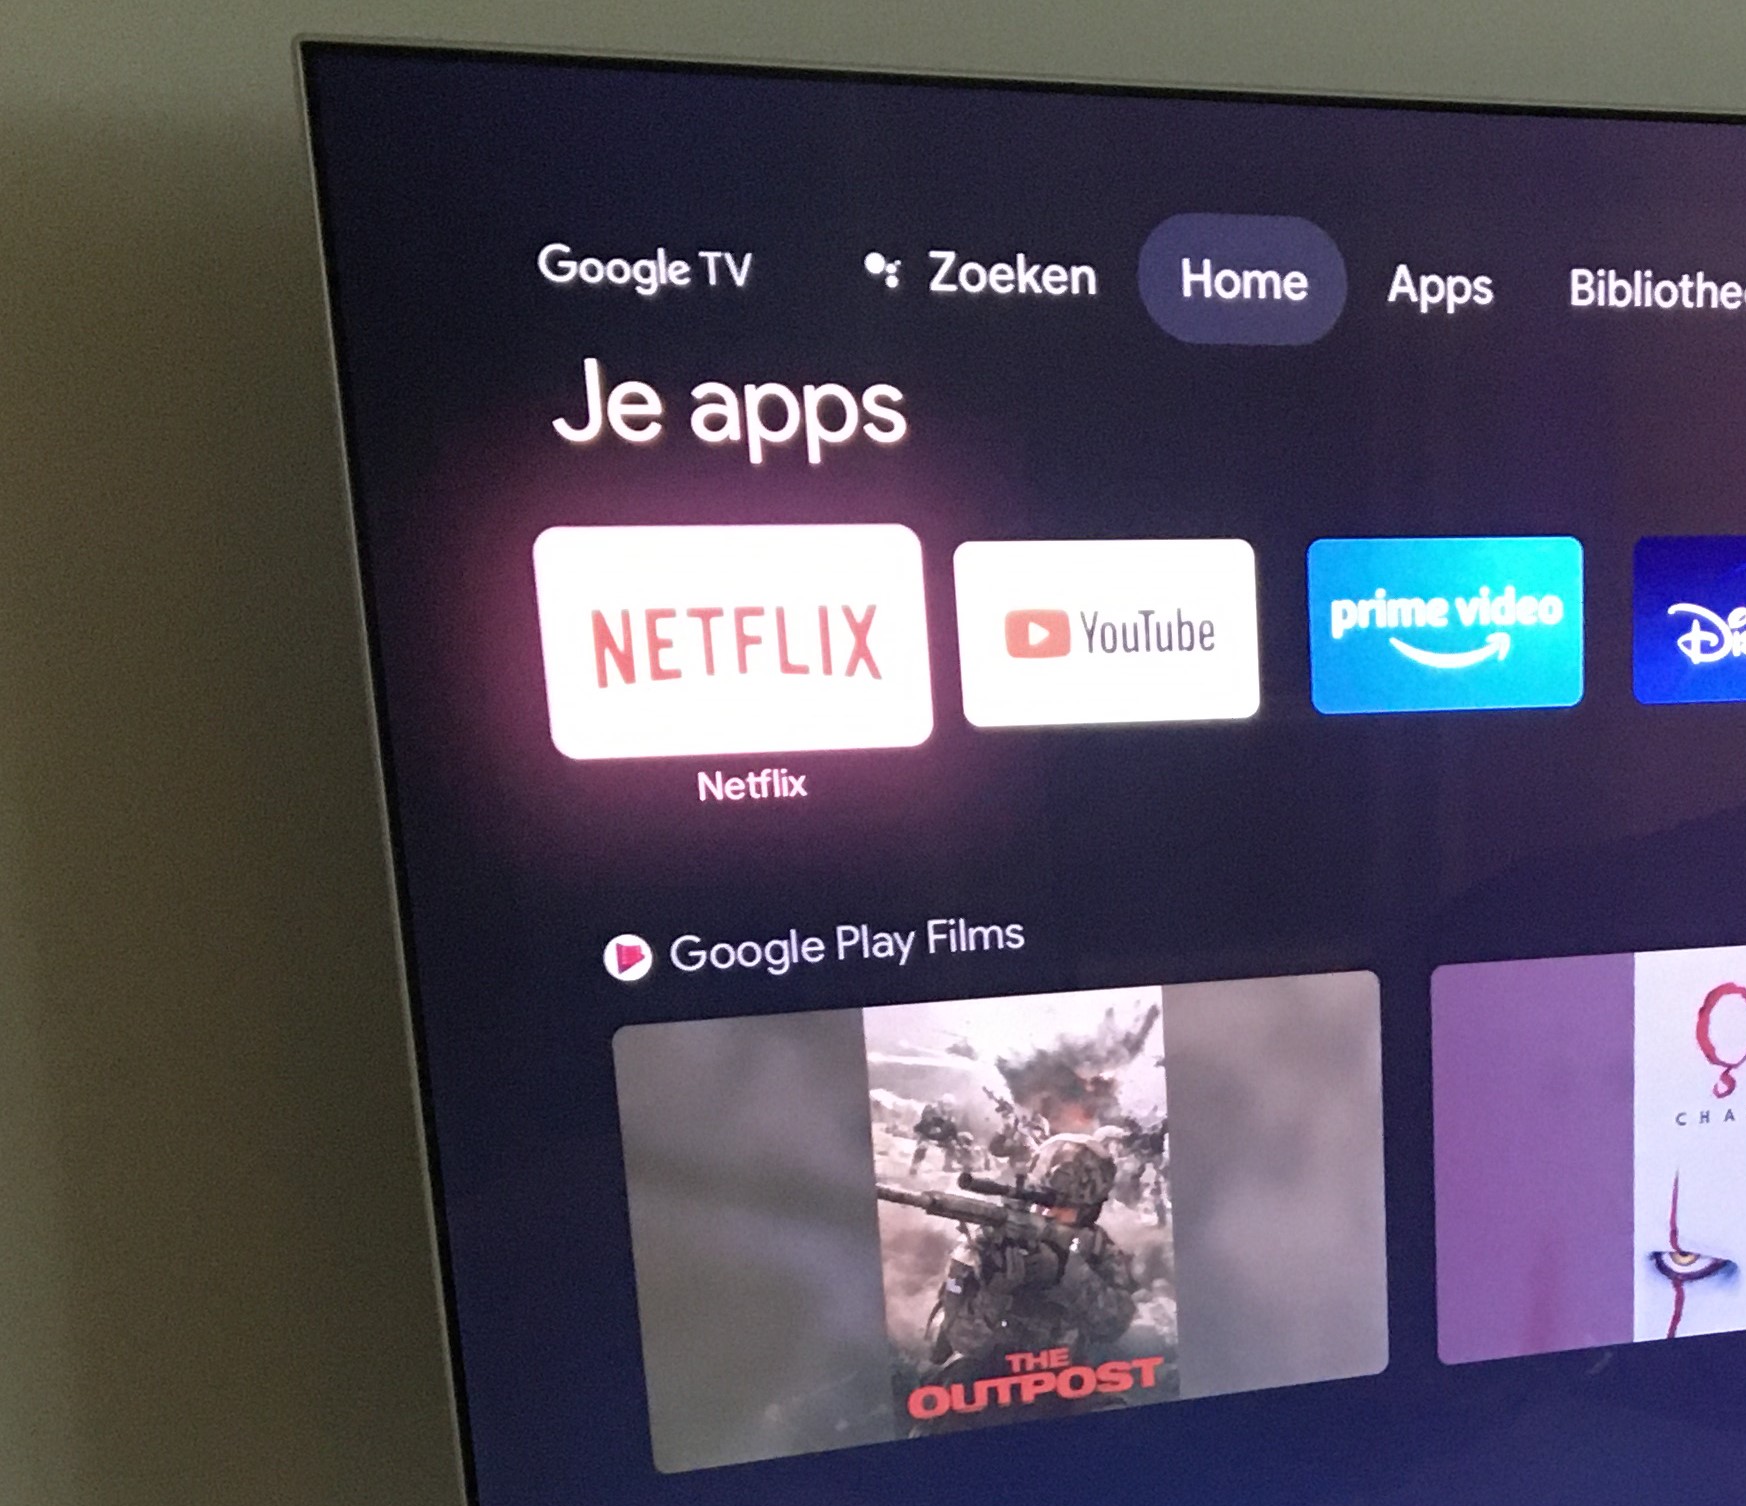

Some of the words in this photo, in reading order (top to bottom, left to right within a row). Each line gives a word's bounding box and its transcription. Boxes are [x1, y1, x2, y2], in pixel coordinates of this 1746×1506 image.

[537, 242, 692, 295] Google
[699, 250, 753, 287] TV
[928, 249, 1097, 295] Zoeken
[1180, 257, 1309, 301] Home
[1387, 264, 1494, 313] Apps
[551, 357, 663, 443] Je
[690, 379, 908, 465] apps
[1080, 608, 1216, 654] YouTube
[1330, 587, 1449, 639] prime
[1454, 584, 1564, 627] video
[590, 603, 883, 688] NETFLIX
[697, 768, 808, 803] Netflix
[669, 929, 825, 975] Google
[835, 922, 916, 968] Play
[927, 917, 1025, 955] Films
[1005, 1347, 1071, 1373] THE
[907, 1356, 1165, 1421] OUTPOST
